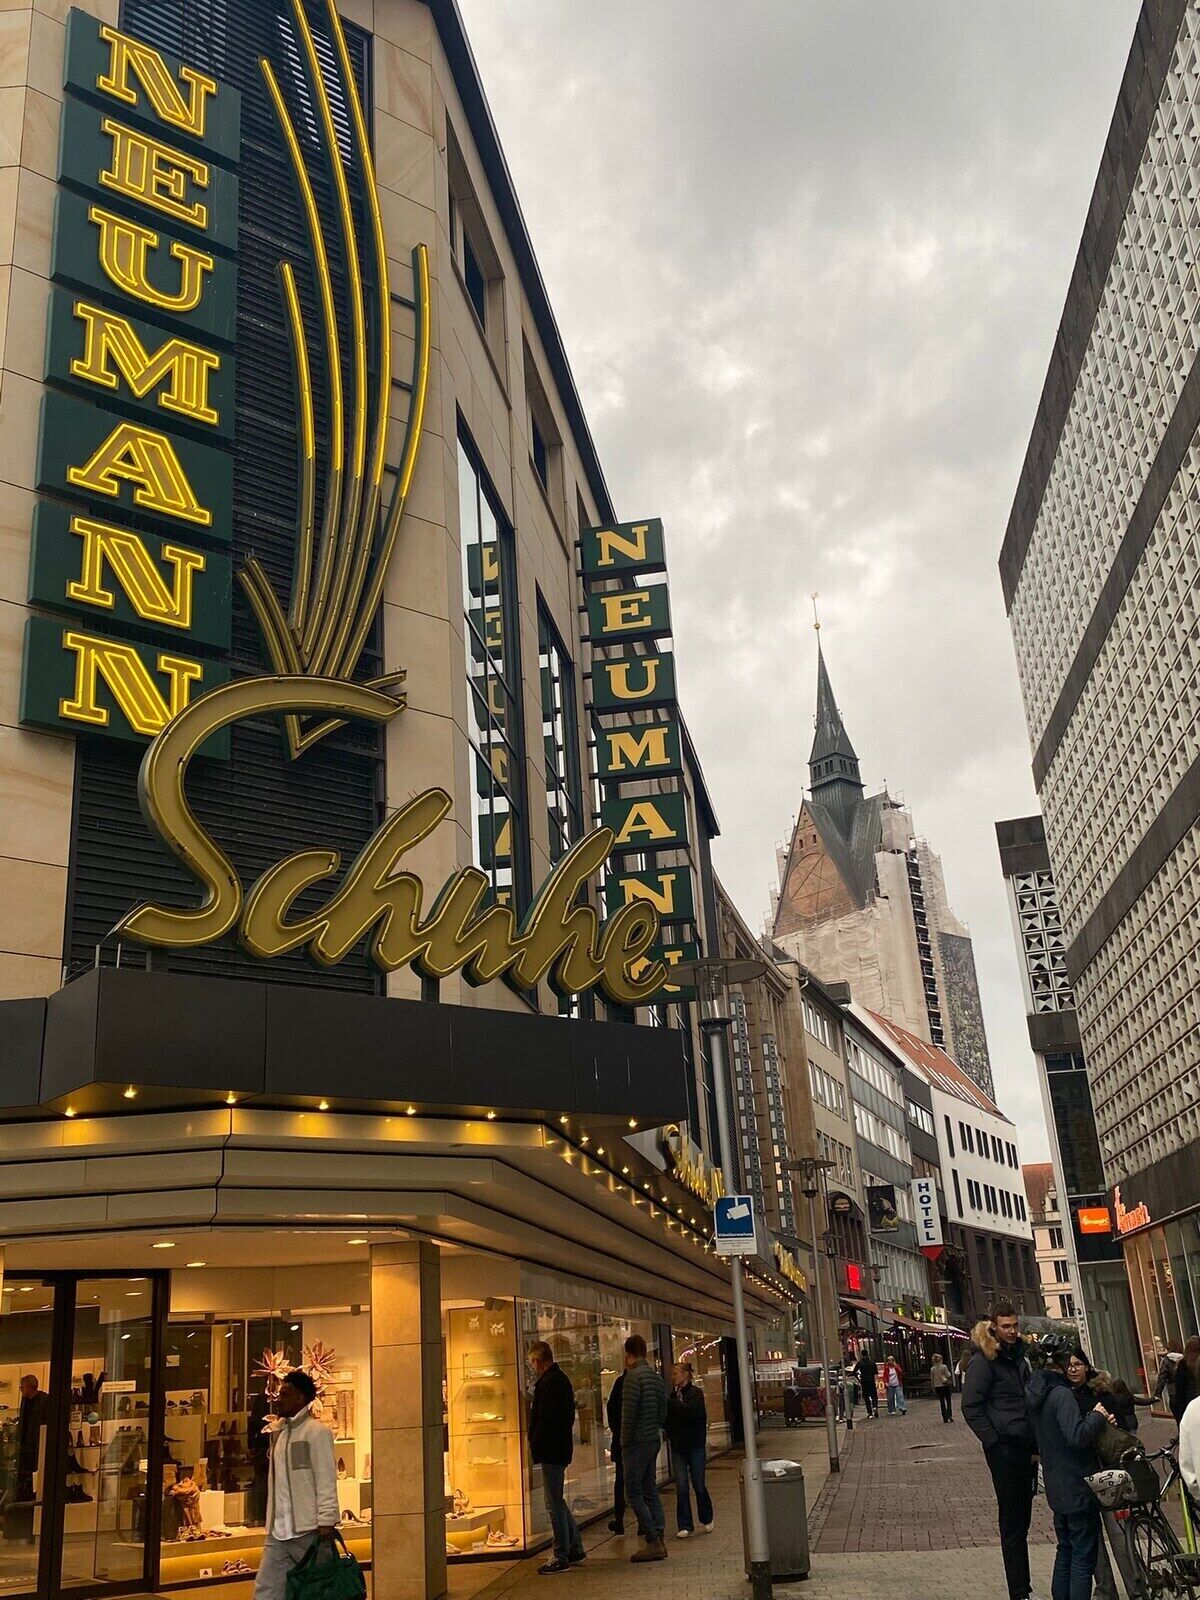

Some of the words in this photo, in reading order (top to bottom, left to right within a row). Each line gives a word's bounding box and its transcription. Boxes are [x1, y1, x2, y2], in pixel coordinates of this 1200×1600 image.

[59, 23, 220, 738] NEUMANN
[120, 671, 671, 1005] Schuhe
[917, 1182, 936, 1242] HOTEL
